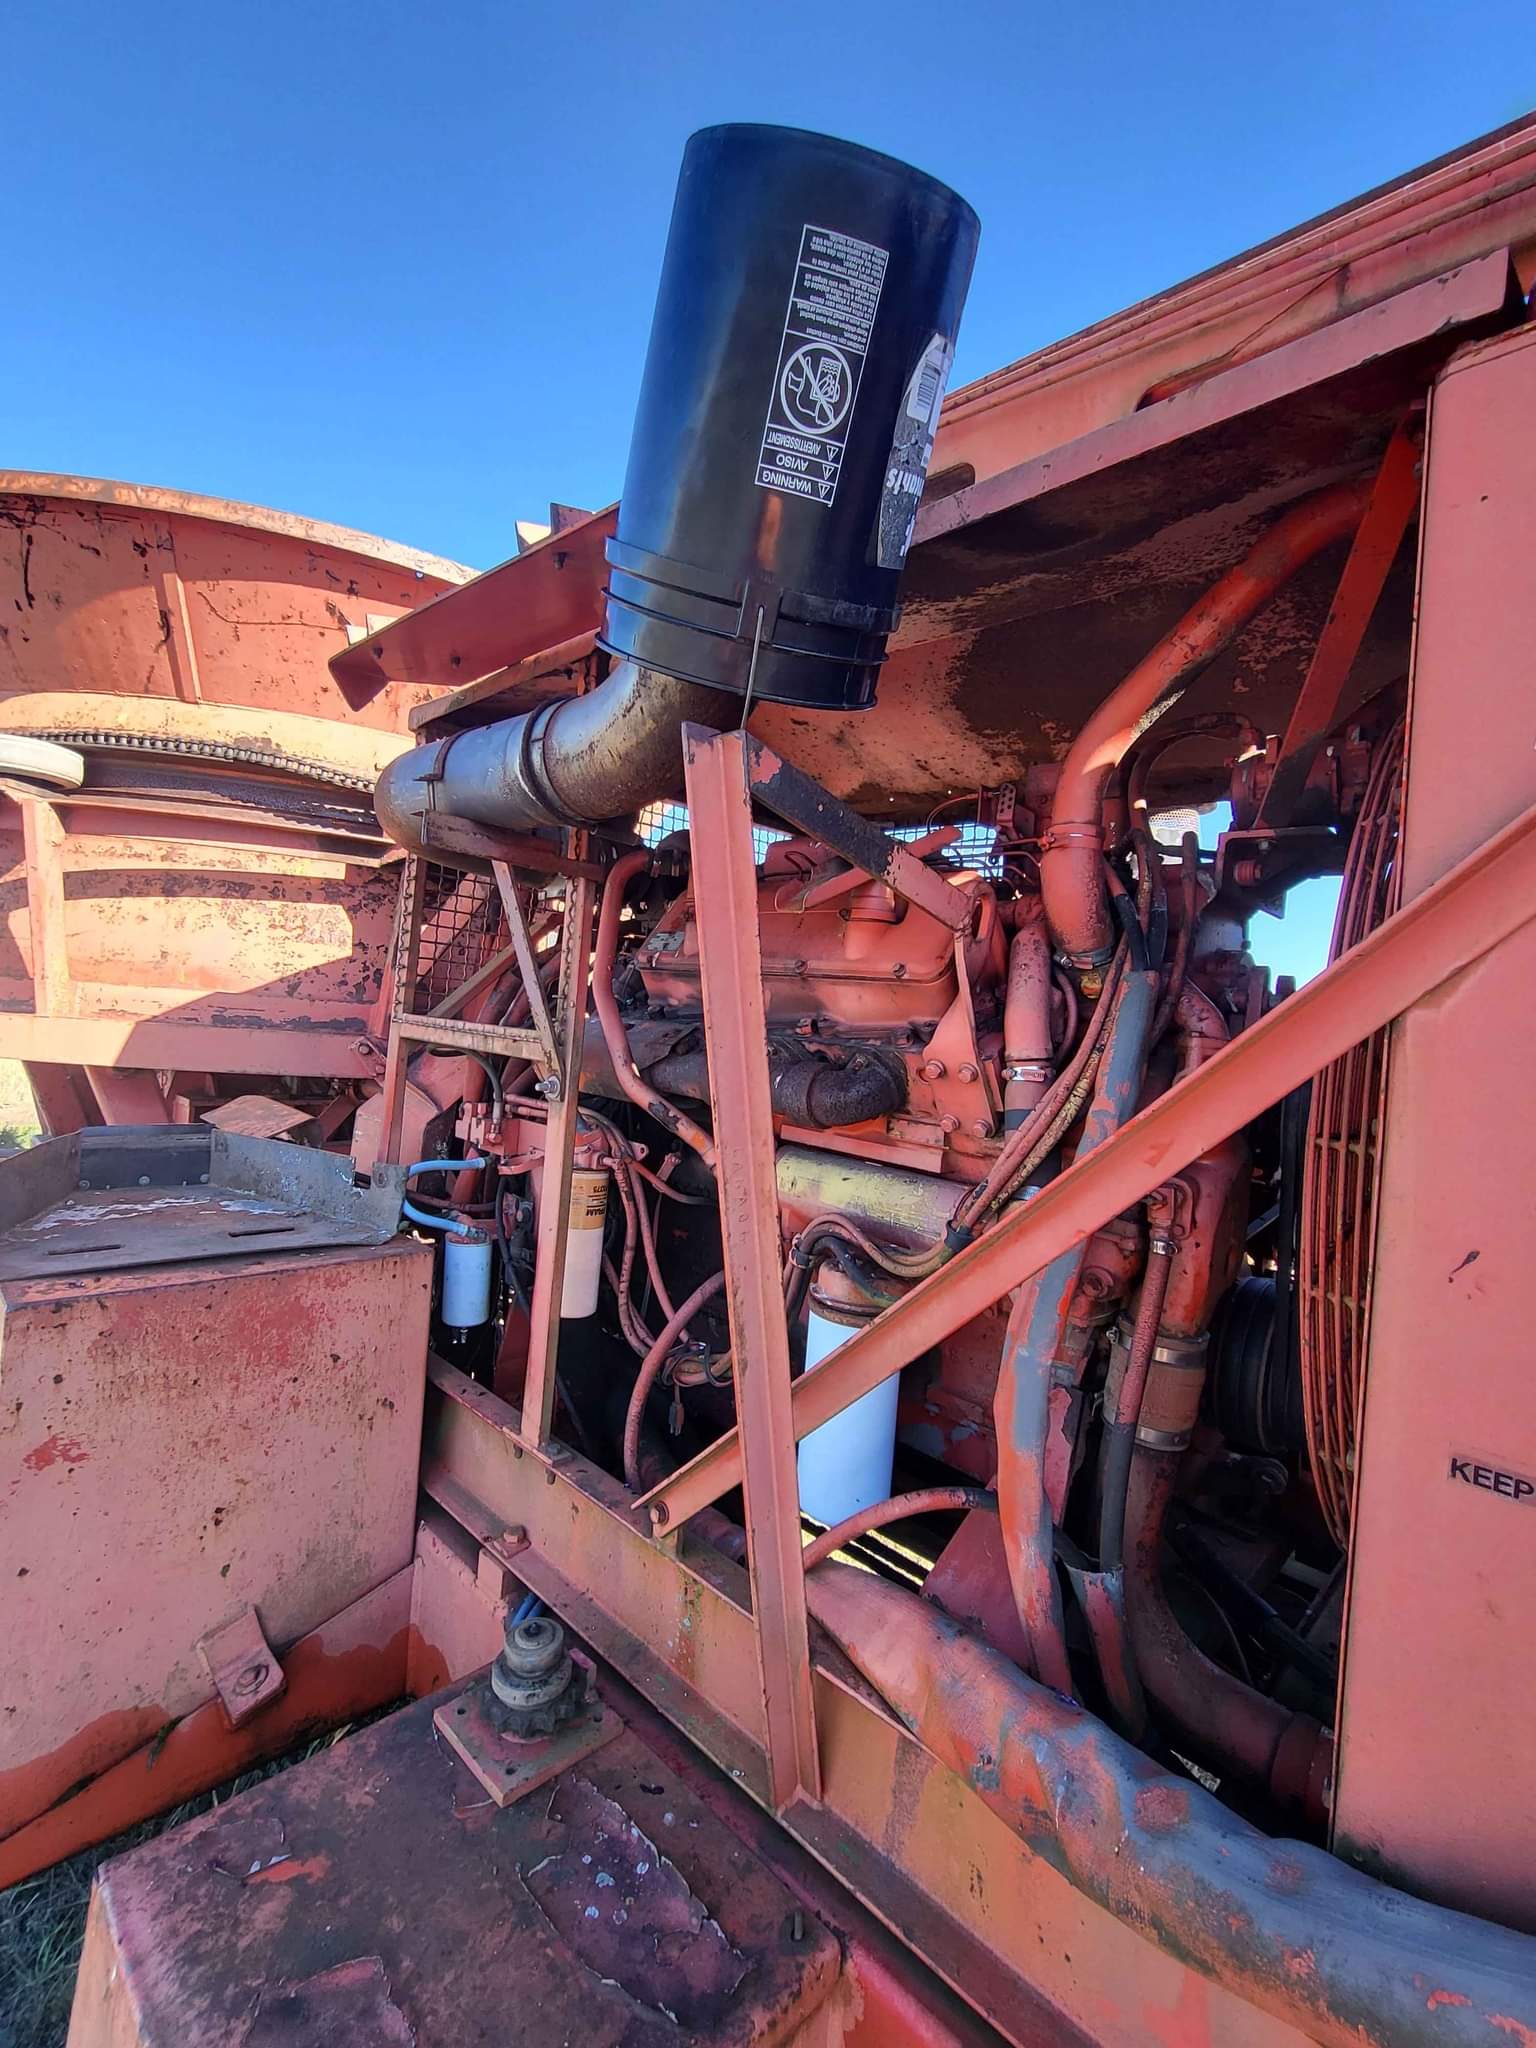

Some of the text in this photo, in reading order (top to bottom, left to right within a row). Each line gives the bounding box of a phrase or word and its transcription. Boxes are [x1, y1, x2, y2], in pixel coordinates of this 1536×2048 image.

[767, 431, 821, 455] AVERTISSEMENT
[776, 454, 808, 471] AVISO
[762, 470, 812, 494] WARNING
[1450, 1457, 1534, 1499] KEEP
